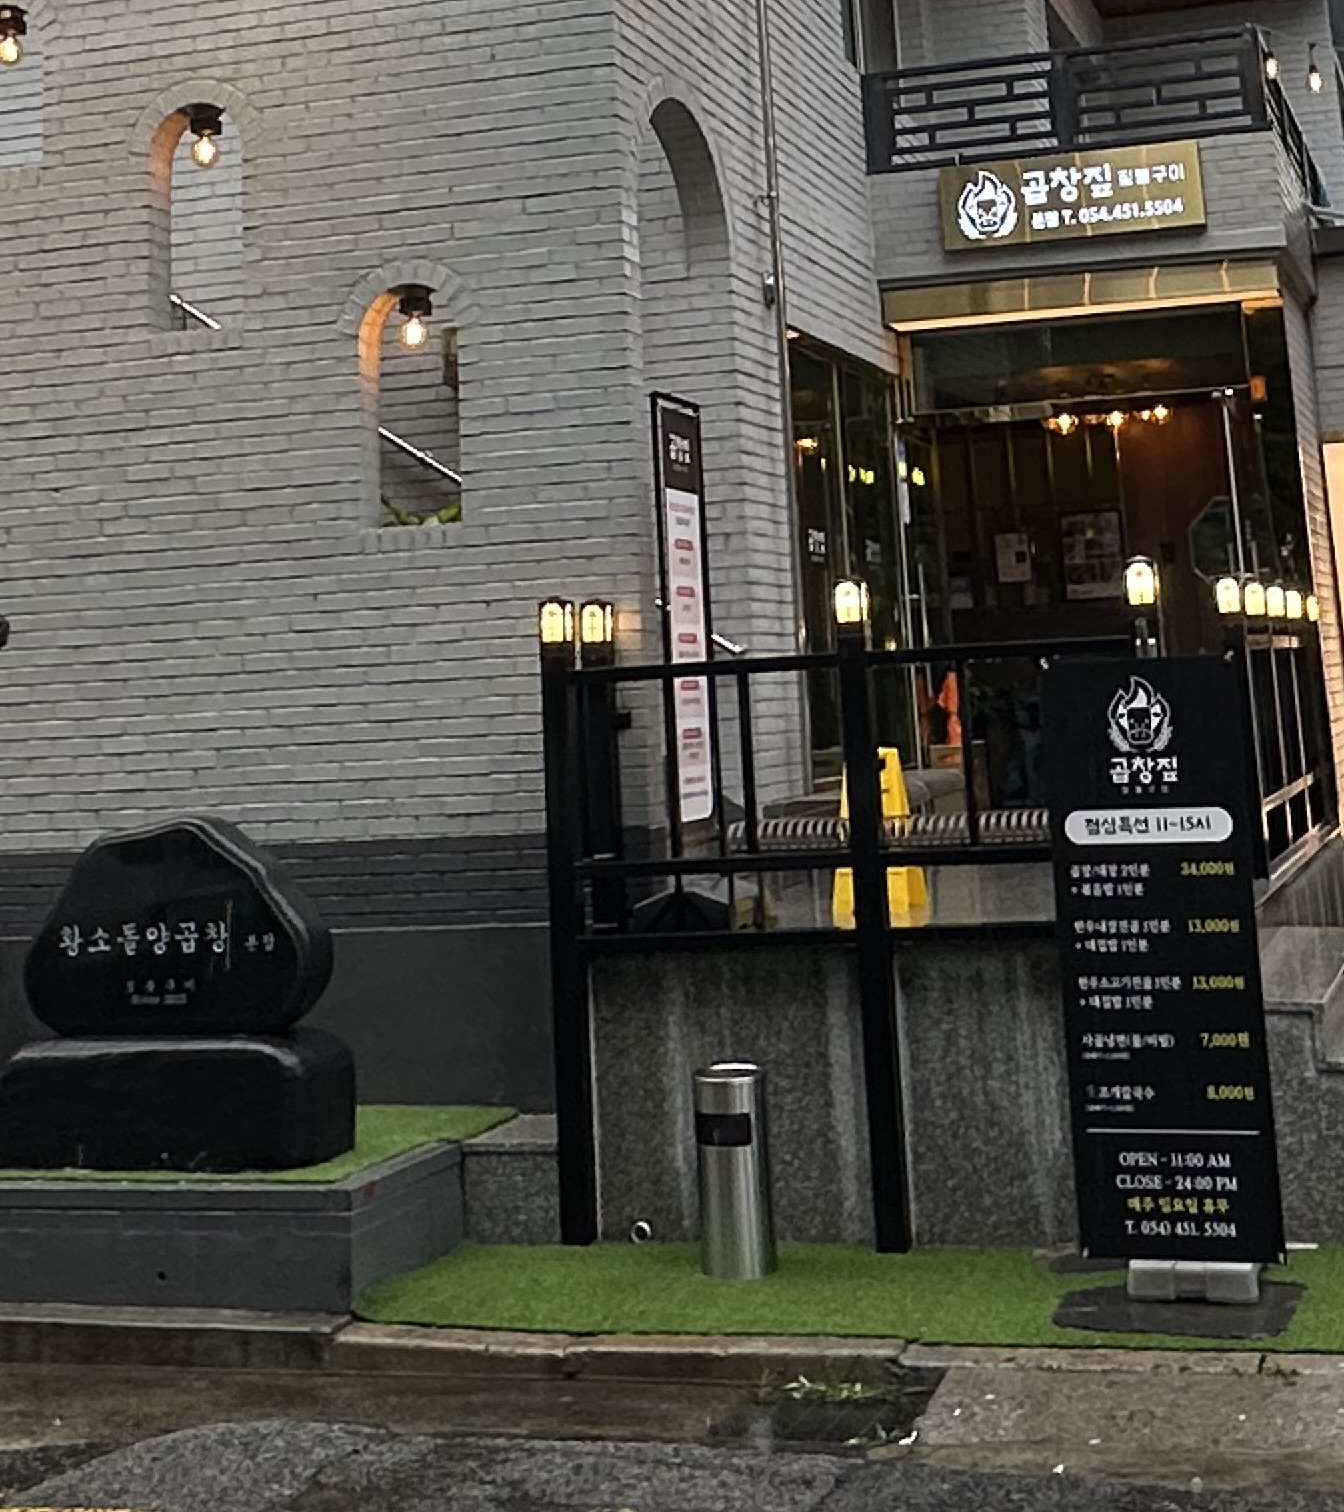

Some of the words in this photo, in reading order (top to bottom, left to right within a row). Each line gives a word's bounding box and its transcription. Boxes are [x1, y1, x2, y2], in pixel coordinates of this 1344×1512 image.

[1020, 162, 1114, 206] 곱창집
[1109, 755, 1180, 784] 곱창집
[1118, 1151, 1159, 1168] OPEN
[1170, 1152, 1205, 1168] 11:00
[1207, 1152, 1232, 1169] AM
[1115, 1173, 1164, 1190] CLOSE
[1216, 1176, 1239, 1192] PM
